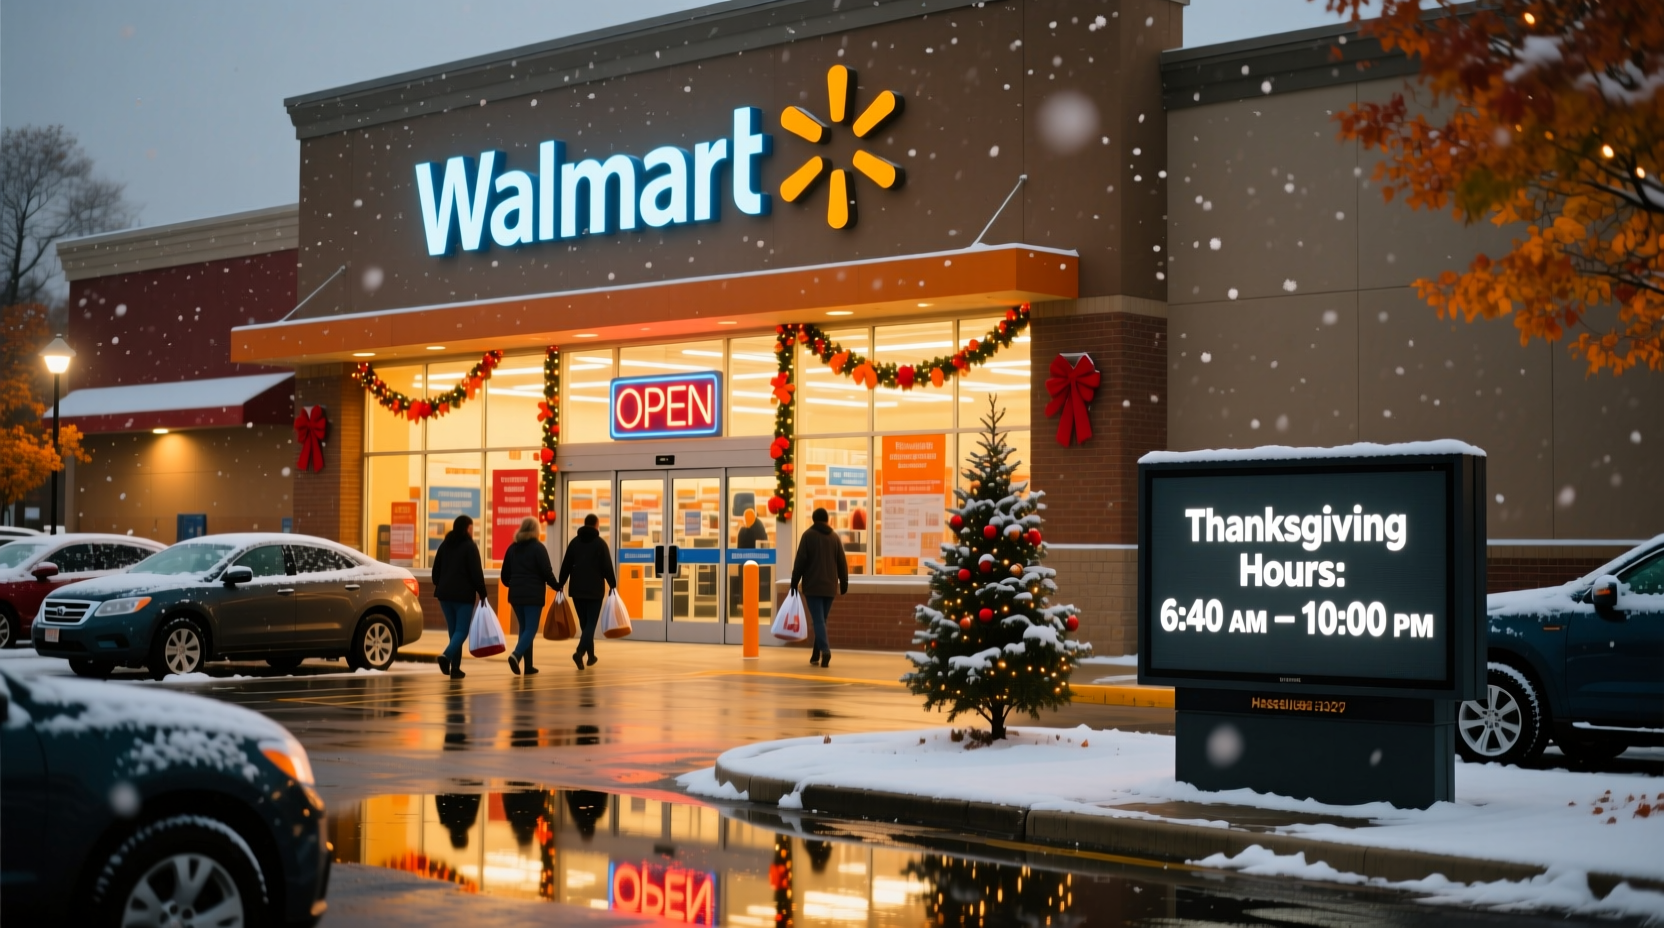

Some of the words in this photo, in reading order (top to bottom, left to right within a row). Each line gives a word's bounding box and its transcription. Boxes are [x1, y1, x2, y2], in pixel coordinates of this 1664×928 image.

[414, 106, 770, 256] Walmart
[616, 384, 713, 429] OPEN
[1184, 504, 1407, 551] Thanksgiving
[1239, 552, 1346, 588] Hours:
[1160, 598, 1224, 633] 6:40
[1228, 609, 1268, 634] AM
[1301, 600, 1387, 637] 10:00
[1393, 613, 1434, 638] PM
